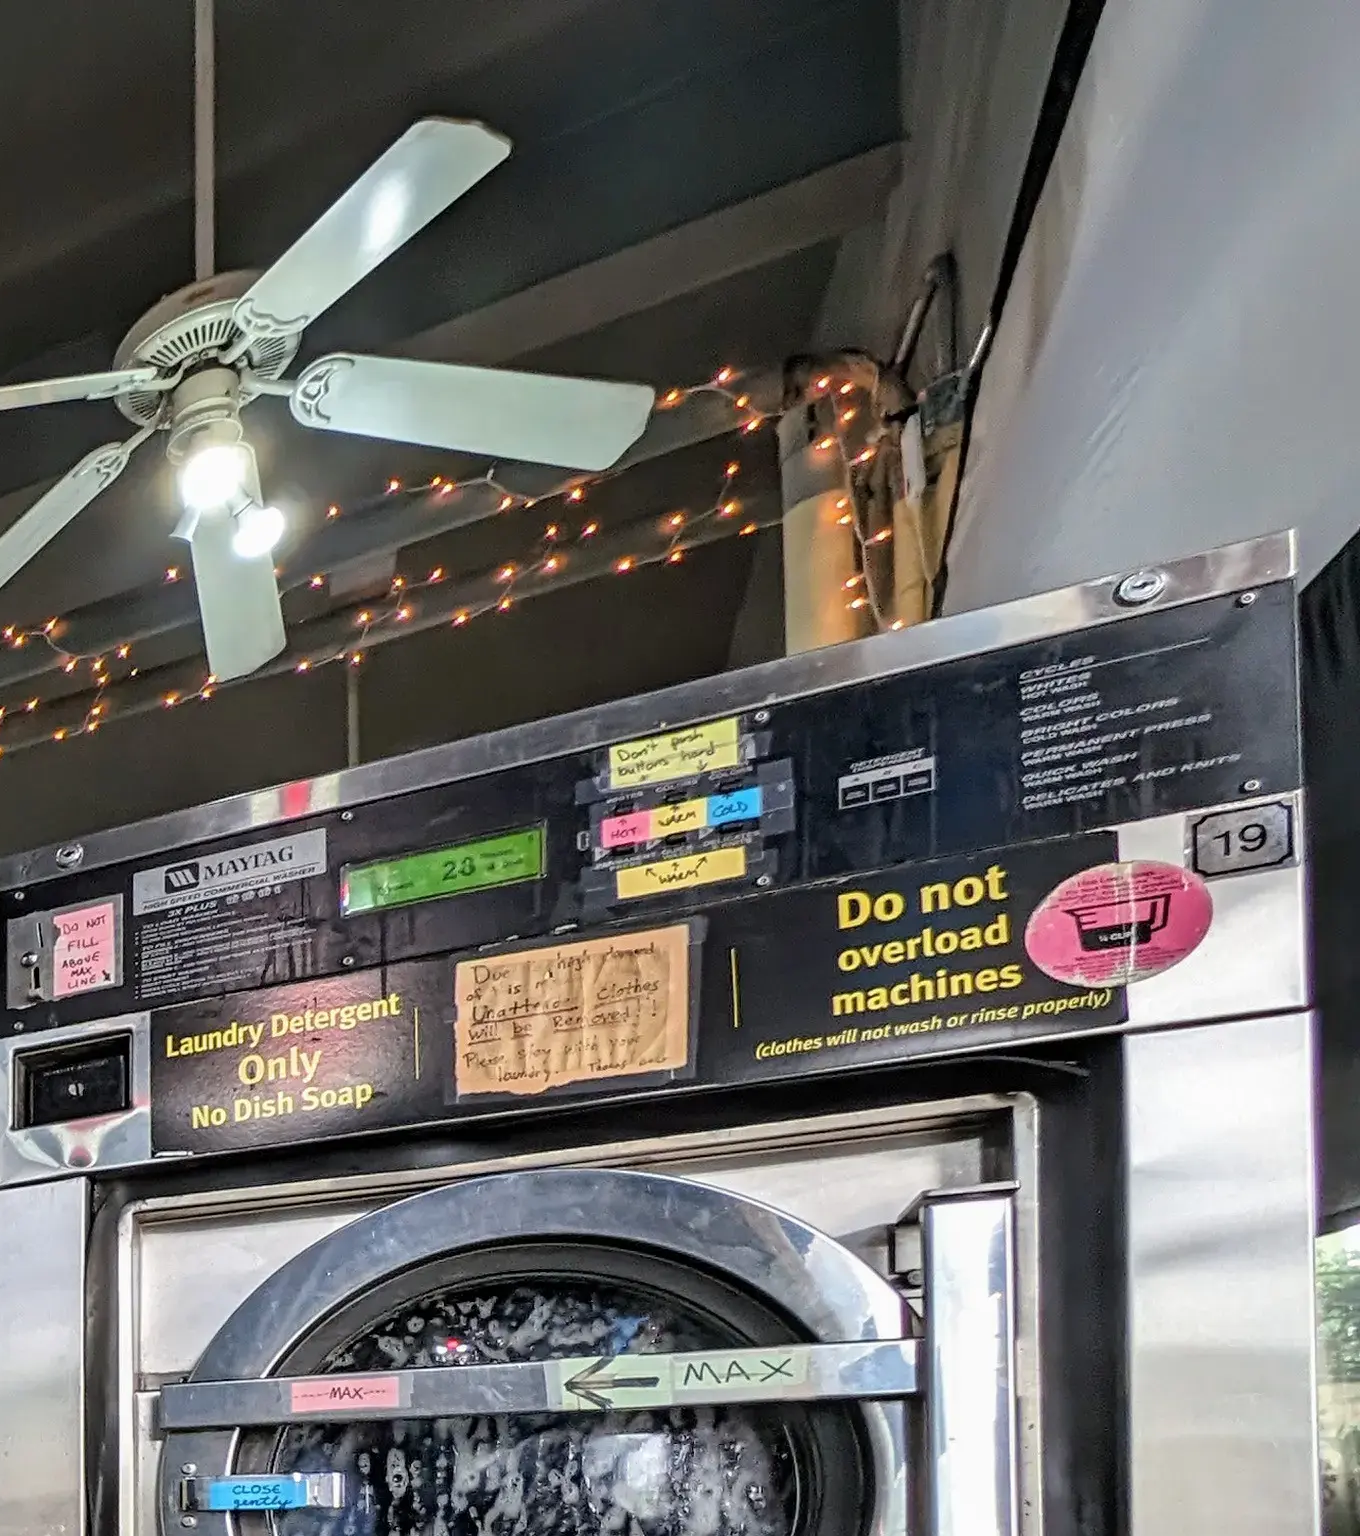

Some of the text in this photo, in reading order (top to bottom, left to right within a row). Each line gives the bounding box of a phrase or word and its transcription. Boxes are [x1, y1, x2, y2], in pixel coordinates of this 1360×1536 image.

[1019, 656, 1096, 680] CYCLES
[1020, 671, 1092, 694] WHITES
[1020, 692, 1099, 716] COLORS
[1020, 697, 1181, 739] BRIGHT COLORS
[671, 730, 704, 749] push
[1020, 713, 1213, 760] PERMANENT PRESS
[680, 741, 716, 761] hard
[1021, 752, 1139, 782] QUICK WASH
[1022, 752, 1243, 804] DELICATES AND KNITS
[610, 827, 638, 839] HOT
[712, 801, 748, 818] COLD
[1213, 823, 1268, 857] 19
[203, 845, 294, 881] MAYTAG
[143, 866, 316, 912] HIGH SPEED COMMERCIAL WASHER
[837, 890, 905, 931] Do
[919, 864, 1010, 914] not
[185, 900, 218, 914] PLUS
[63, 915, 106, 935] DO NOT
[67, 937, 100, 952] FILL
[837, 911, 1012, 973] overload
[62, 951, 100, 969] ABOVE
[71, 966, 92, 978] MAX
[68, 975, 97, 989] LINE
[596, 978, 661, 1001] Clothes
[831, 963, 1025, 1018] machines
[166, 992, 401, 1058] Laundry Detergent
[468, 1021, 498, 1041] will
[511, 1021, 532, 1035] be
[755, 987, 1112, 1060] (clothes will not wash or rinse properly)
[238, 1045, 322, 1085] Only
[191, 1082, 373, 1129] No Dish Soap
[683, 1357, 794, 1386] MAX
[329, 1386, 364, 1400] MAX
[232, 1484, 282, 1495] CLOSE
[233, 1495, 294, 1507] gently
